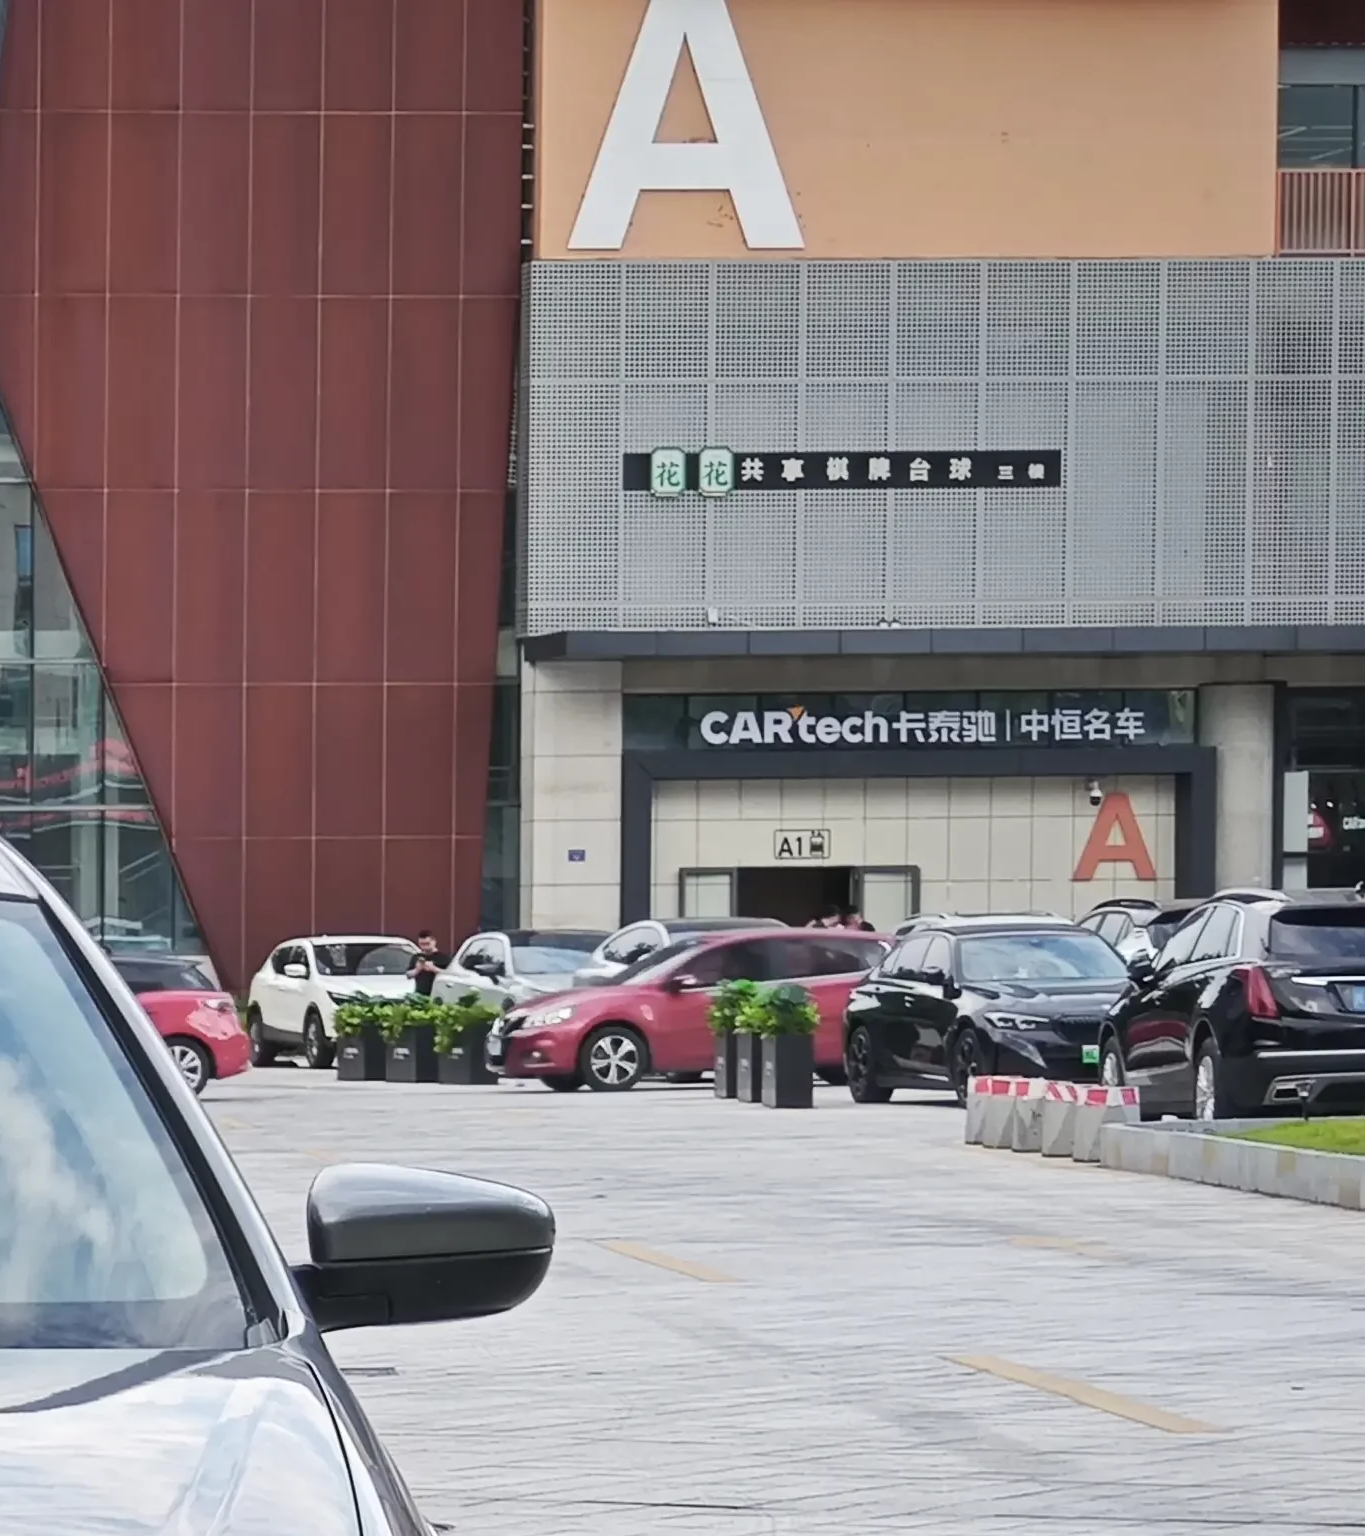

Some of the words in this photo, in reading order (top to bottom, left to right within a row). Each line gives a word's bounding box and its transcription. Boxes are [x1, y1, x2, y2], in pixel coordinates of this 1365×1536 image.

[567, 0, 806, 250] A
[1020, 707, 1146, 741] 中恒名车
[777, 836, 803, 858] A1
[1070, 791, 1157, 881] A
